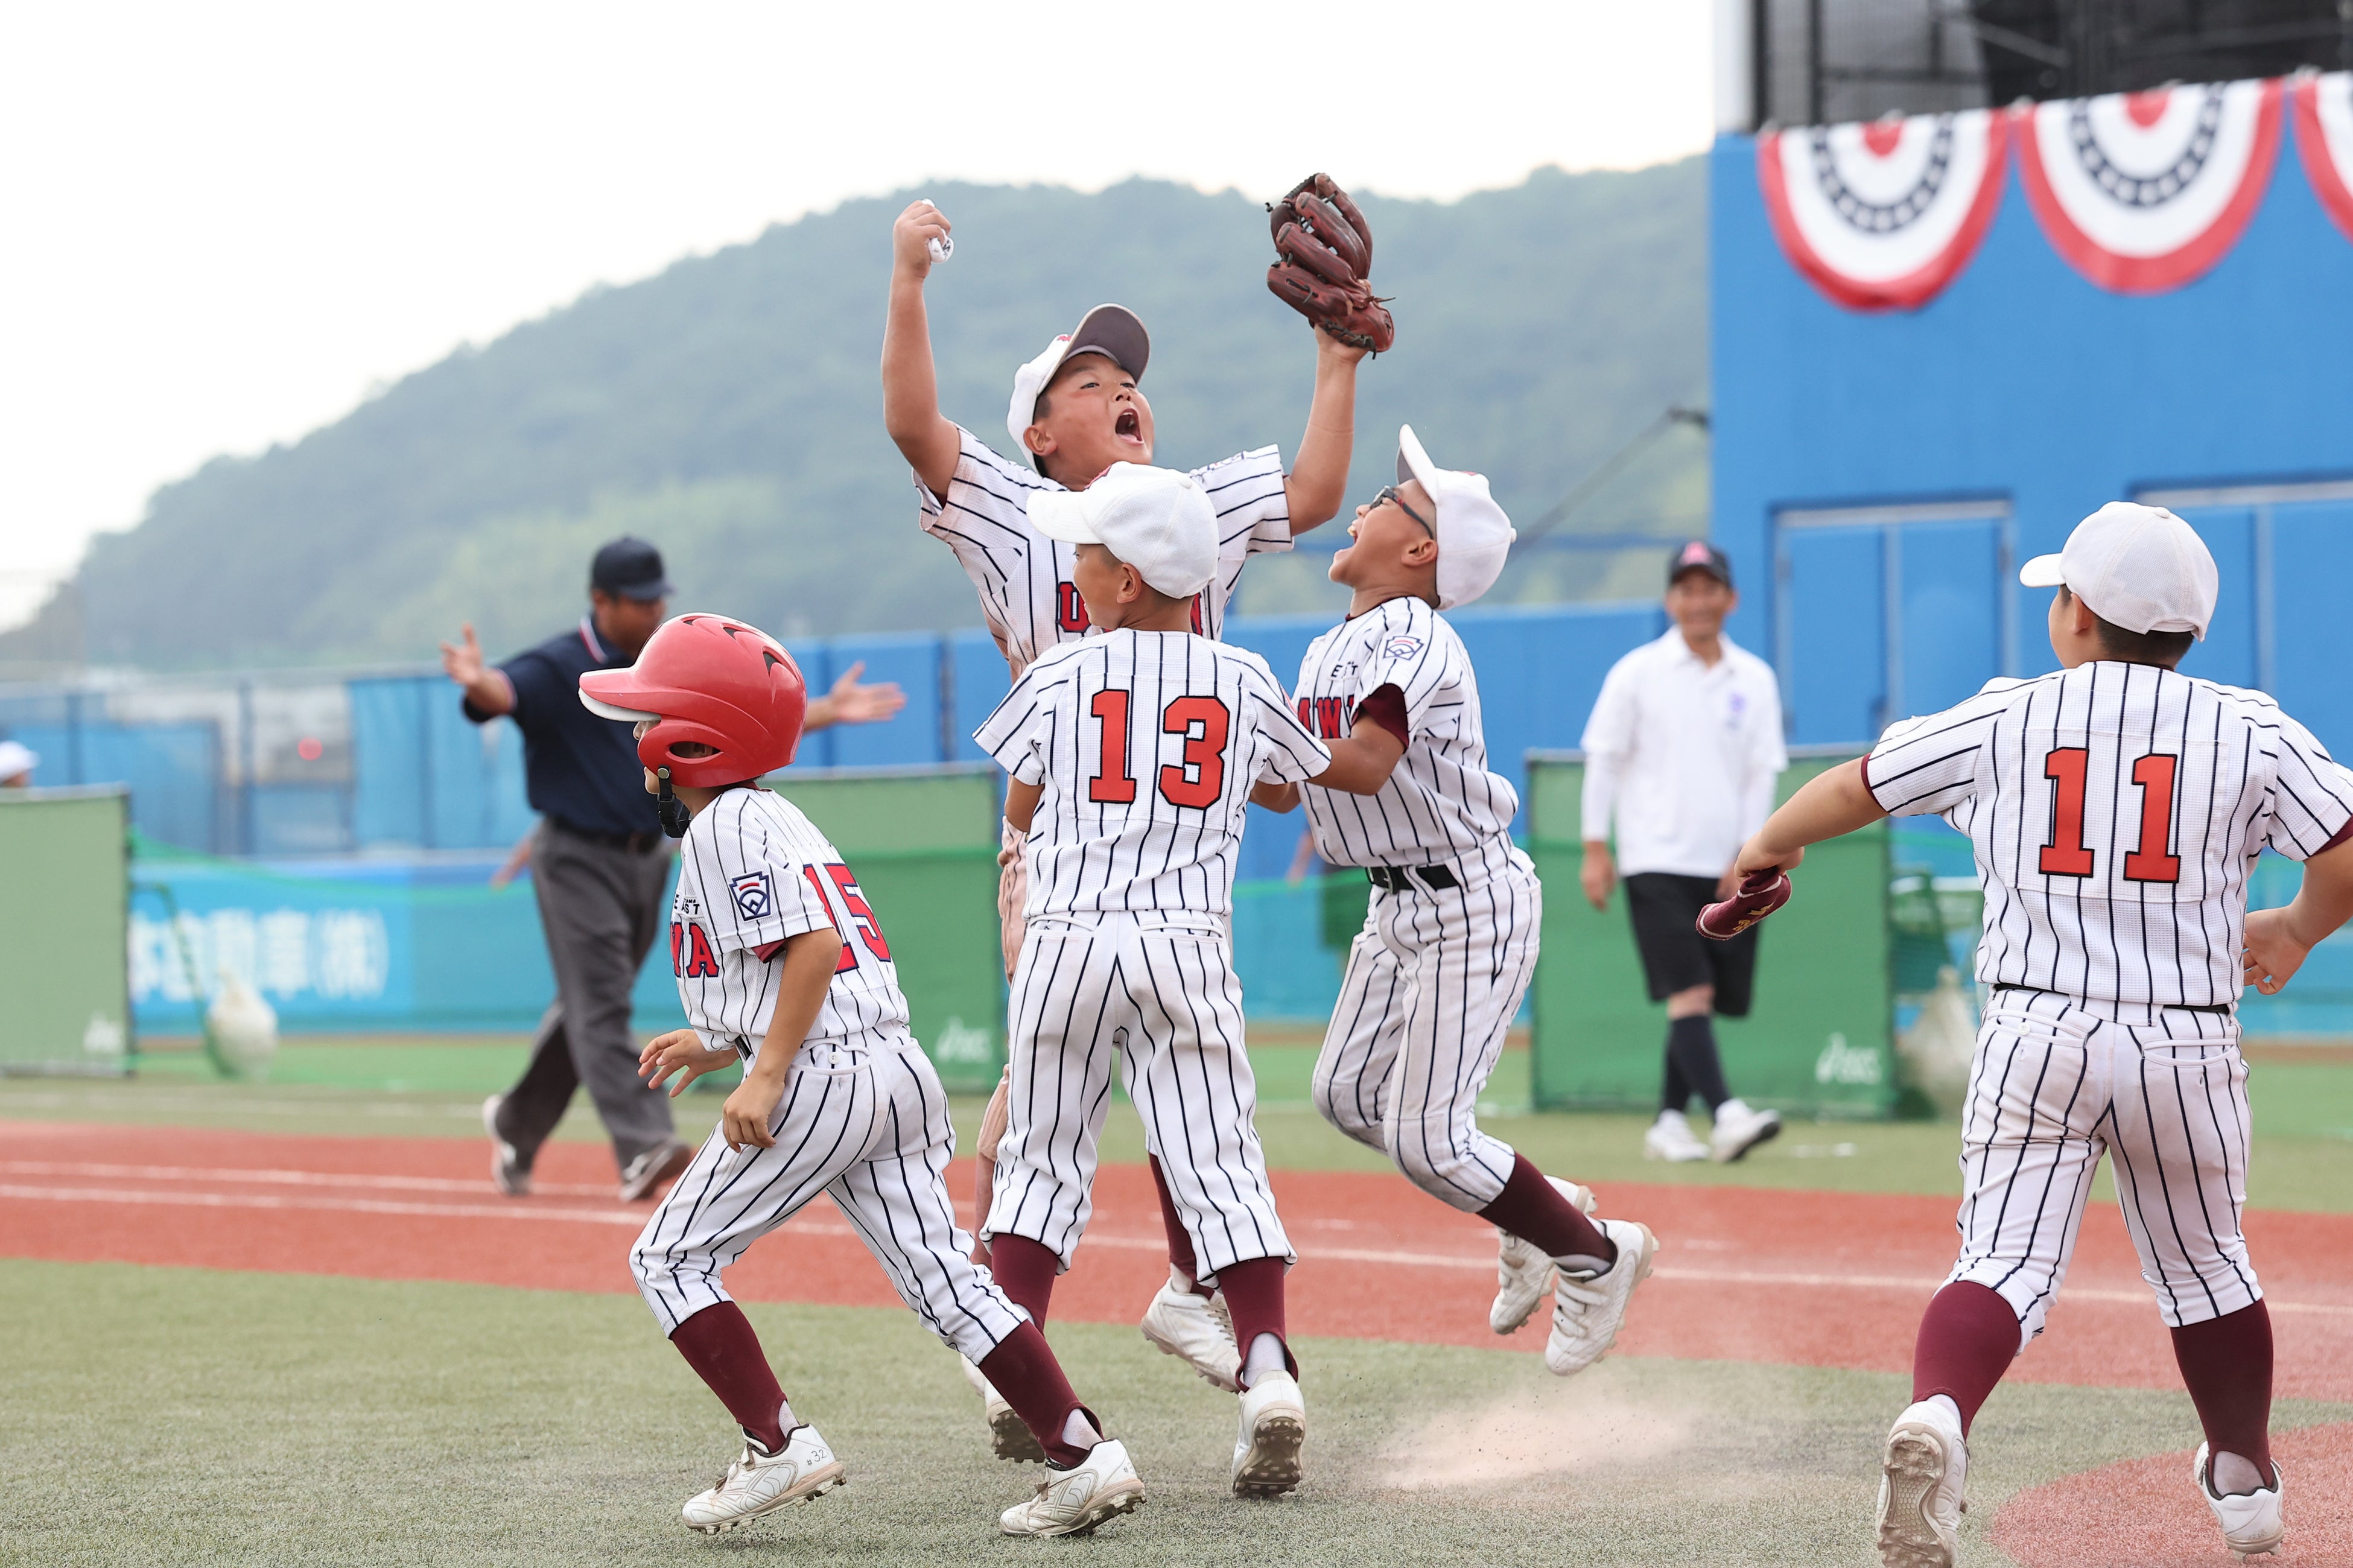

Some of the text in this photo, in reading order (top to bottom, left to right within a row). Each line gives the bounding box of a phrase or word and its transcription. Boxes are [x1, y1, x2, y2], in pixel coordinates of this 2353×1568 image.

[1088, 688, 1230, 810] 13
[2038, 746, 2181, 883] 11
[803, 863, 891, 974] 15
